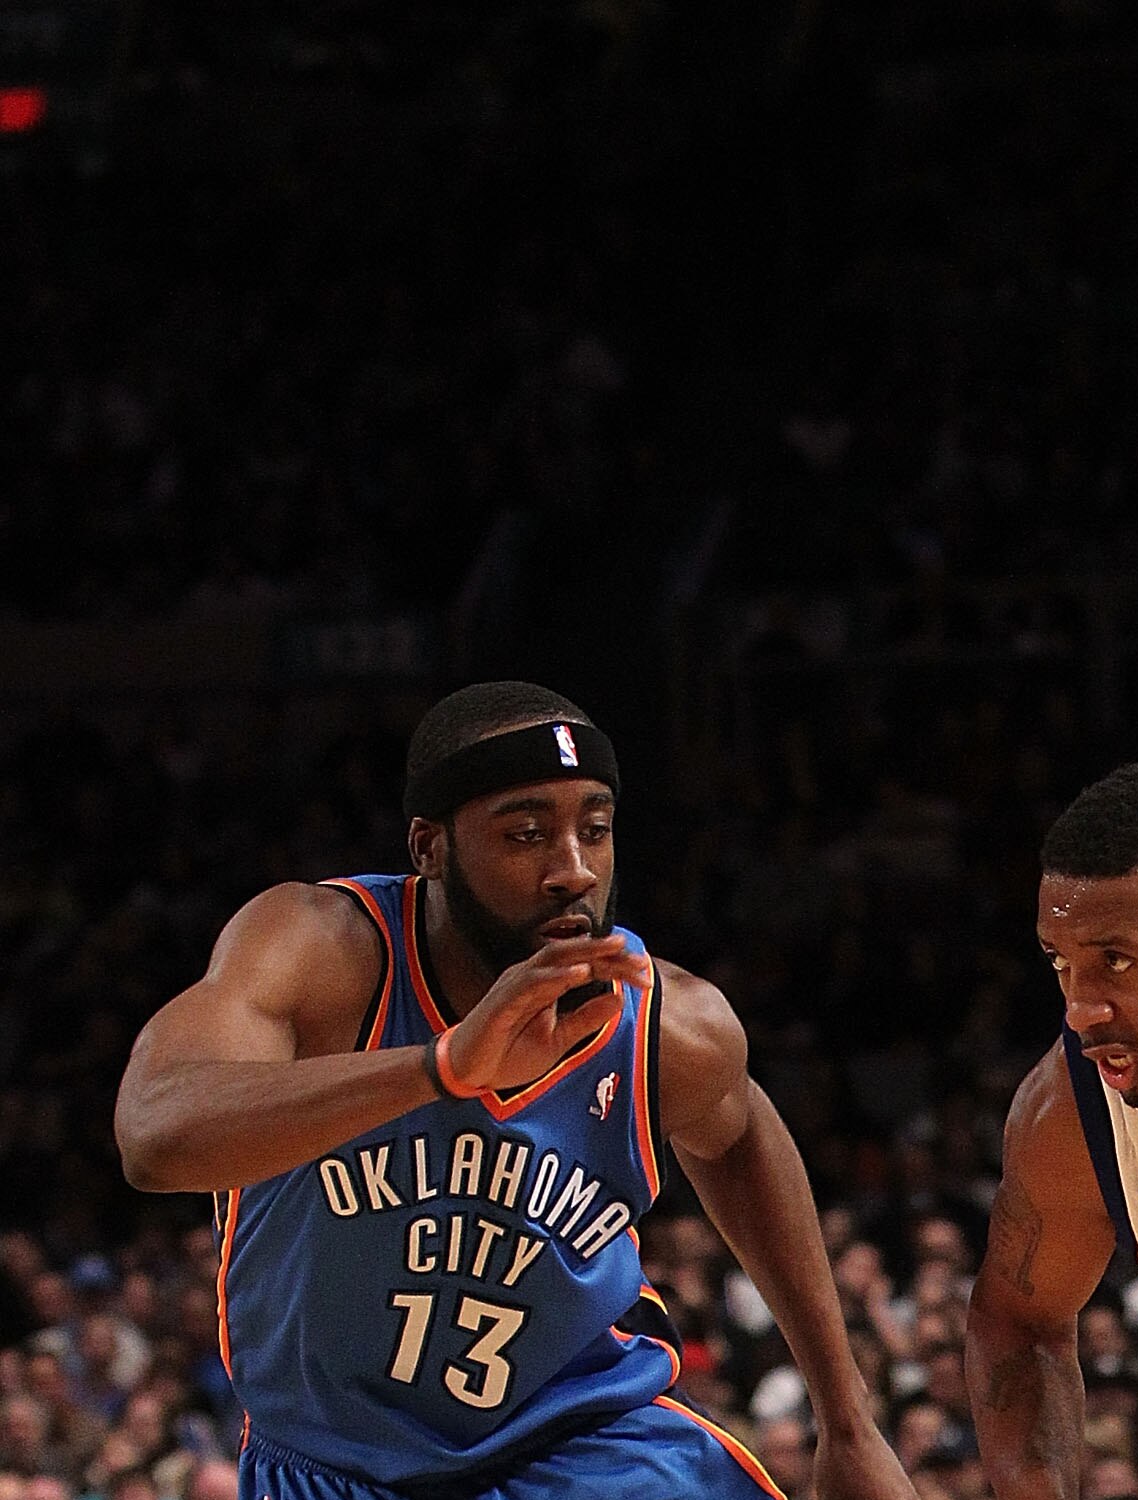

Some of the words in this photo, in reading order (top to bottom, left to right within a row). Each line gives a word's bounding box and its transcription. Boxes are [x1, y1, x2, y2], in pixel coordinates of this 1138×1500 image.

[317, 1131, 632, 1261] OKLAHOMA
[406, 1214, 546, 1288] CITY
[388, 1291, 526, 1410] 13
